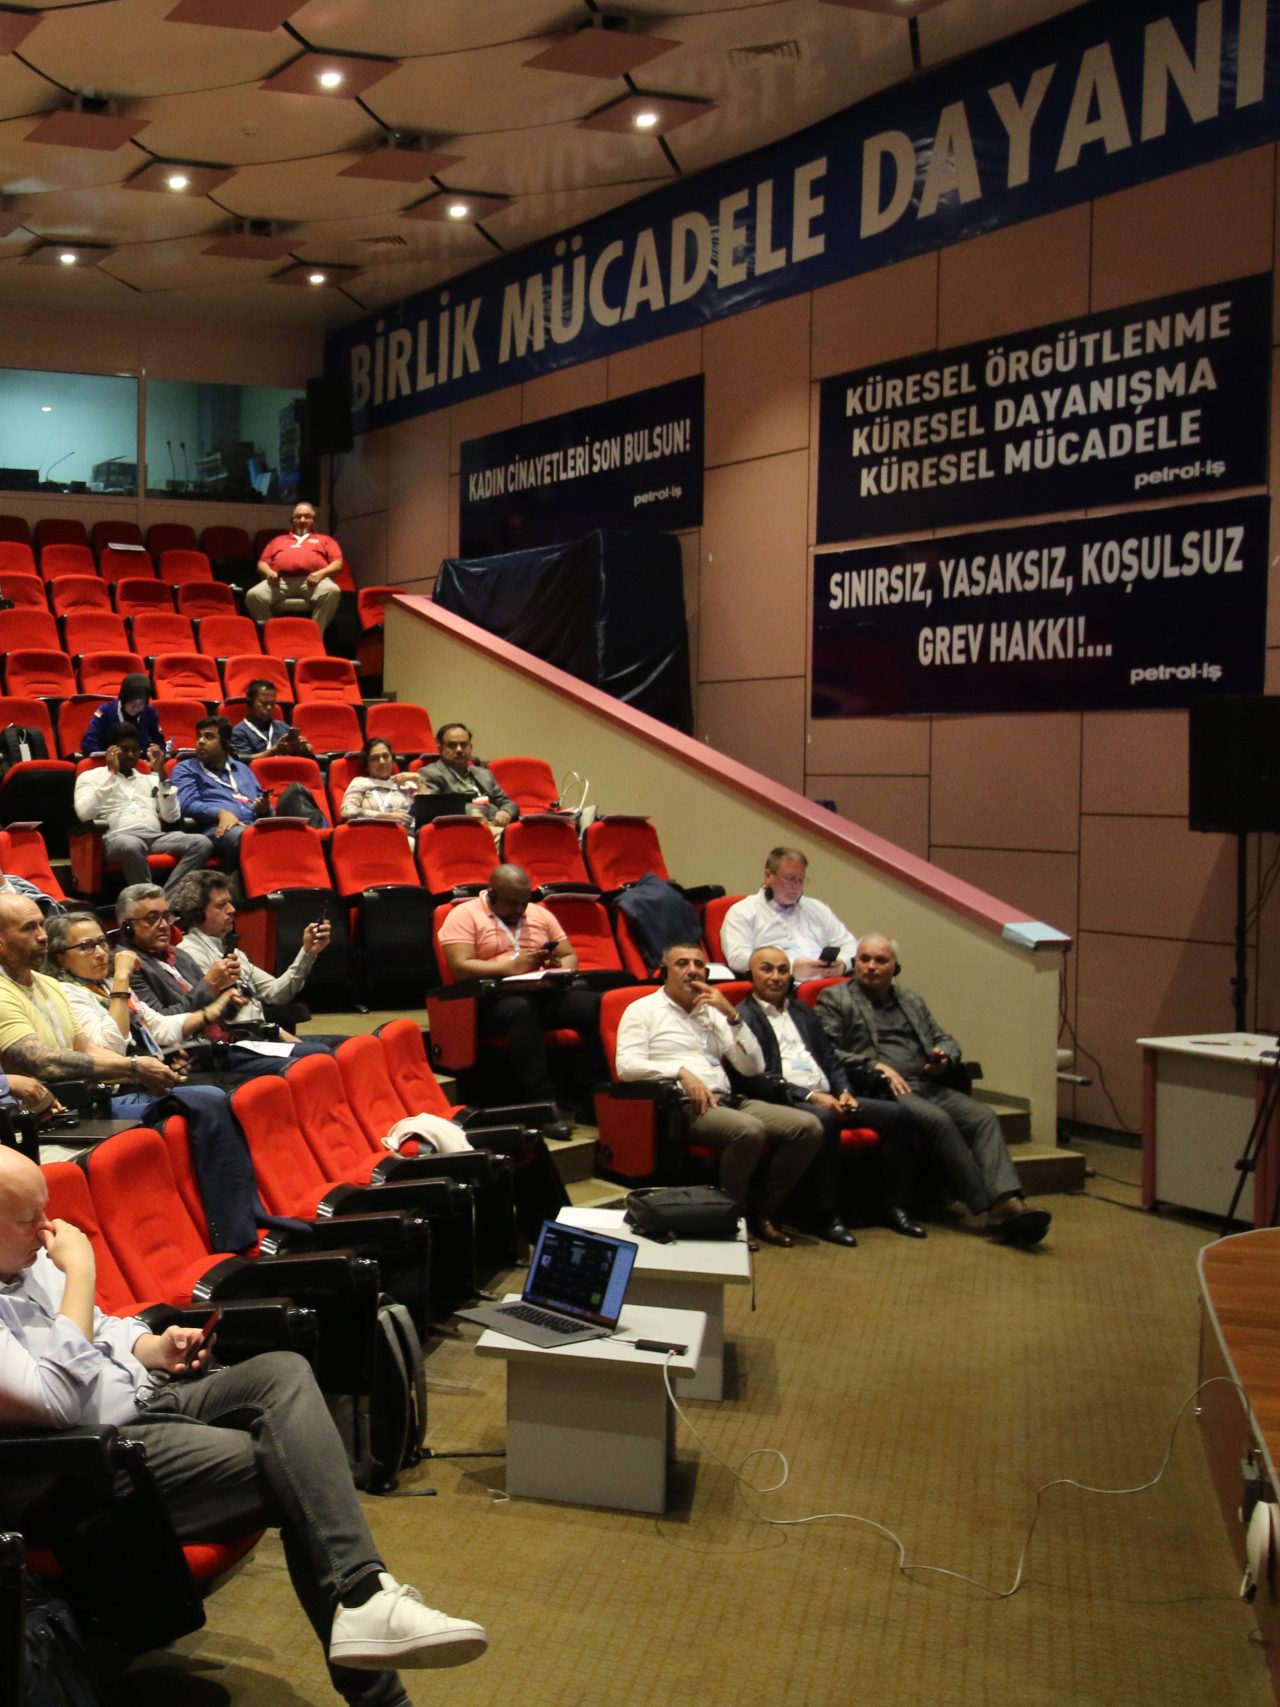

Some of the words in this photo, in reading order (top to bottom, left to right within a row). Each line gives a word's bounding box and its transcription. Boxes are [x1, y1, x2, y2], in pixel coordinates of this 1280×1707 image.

[351, 290, 482, 412] BİRLİK
[499, 157, 827, 363] MÜCADELE
[846, 364, 976, 417] KÜRESEL
[986, 302, 1231, 387] ÖRGÜTLENME
[852, 406, 984, 457] KÜRESEL
[995, 358, 1216, 431] DAYANIŞMA
[469, 466, 505, 502] KADIN
[507, 436, 589, 493] CİNAYETLERİ
[592, 436, 620, 473] SON
[624, 419, 691, 465] BULSUN!
[860, 448, 994, 497] KÜRESEL
[1005, 410, 1202, 474] MÜCADELE
[1134, 460, 1226, 489] petrol-iş
[829, 562, 933, 609] SINIRSIZ,
[939, 547, 1073, 598] YASAKSIZ,
[1082, 526, 1245, 593] KOŞULSUZ
[919, 624, 985, 665] GREV
[990, 616, 1112, 662] HAKKI!...
[1131, 663, 1222, 684] petrol-iş
